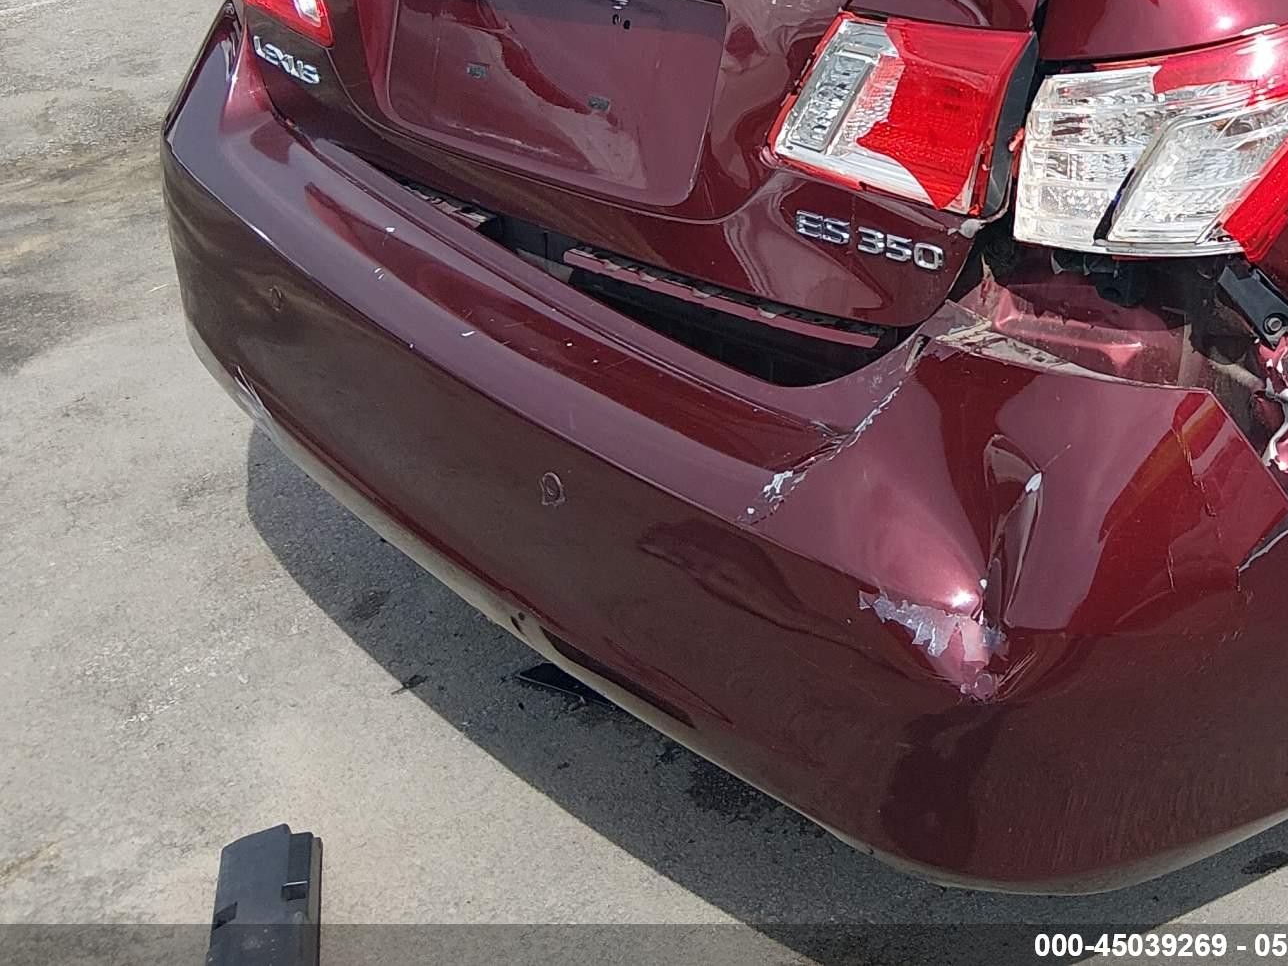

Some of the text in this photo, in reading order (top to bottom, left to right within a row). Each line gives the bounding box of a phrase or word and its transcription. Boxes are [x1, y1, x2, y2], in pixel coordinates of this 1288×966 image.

[253, 35, 320, 84] LEXUS
[796, 210, 944, 270] ES 350
